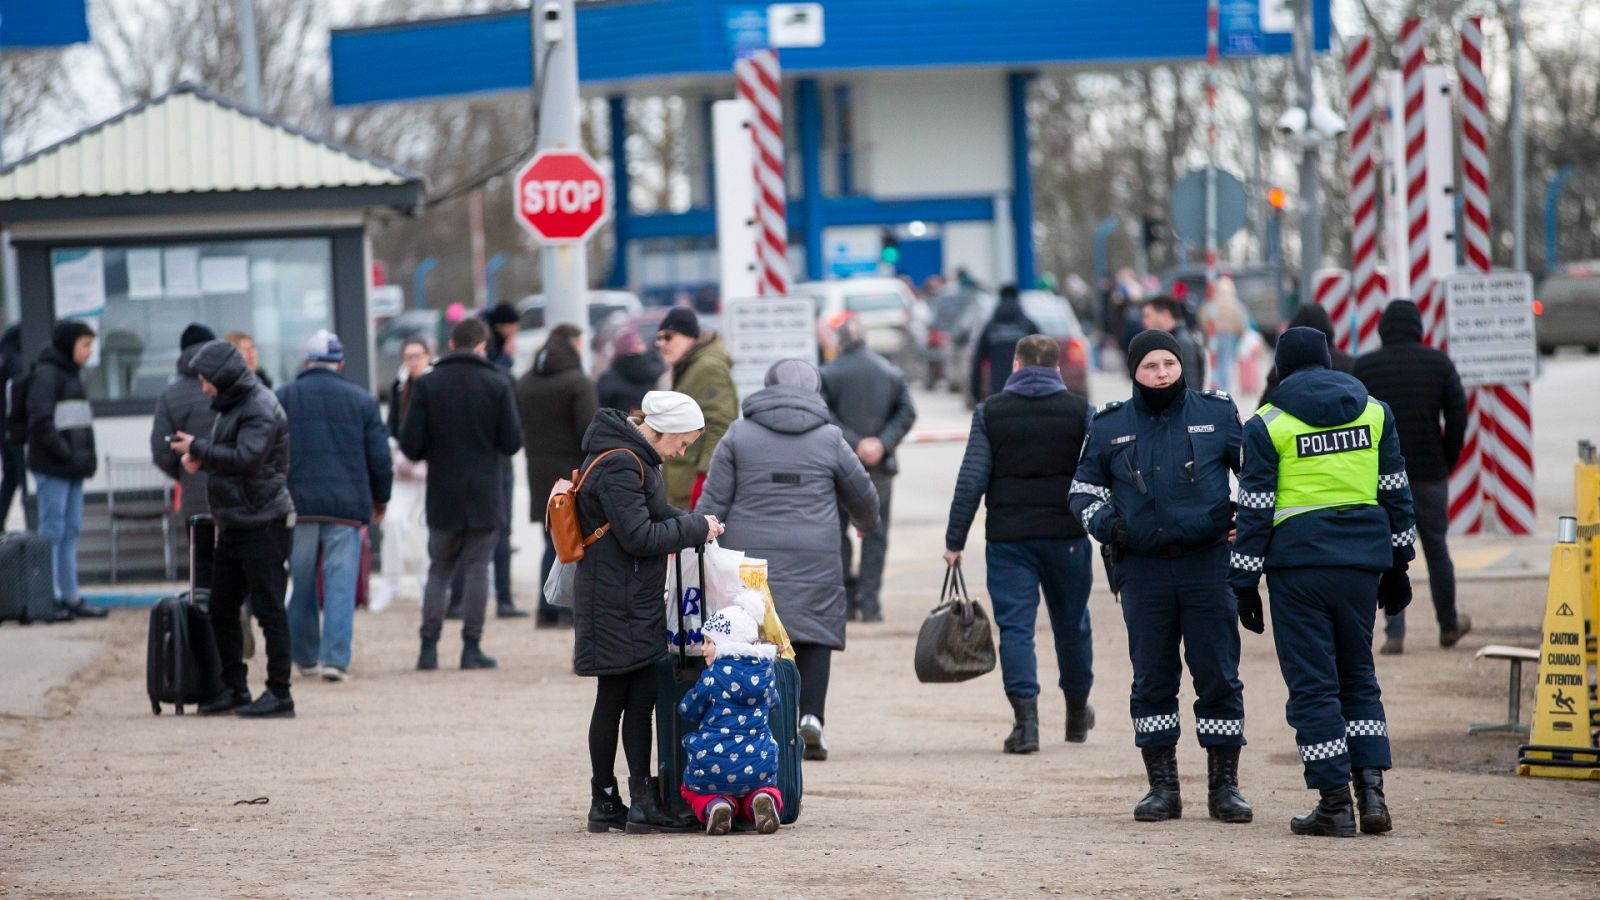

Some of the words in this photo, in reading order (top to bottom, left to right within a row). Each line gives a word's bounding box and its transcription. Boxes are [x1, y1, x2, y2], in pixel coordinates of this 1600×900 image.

[524, 180, 601, 214] STOP
[1189, 425, 1214, 433] POLITIA
[1300, 428, 1369, 454] POLITIA
[1550, 632, 1579, 645] CAUTION
[1548, 653, 1581, 666] CUIDADO
[1545, 673, 1583, 686] ATTENTION
